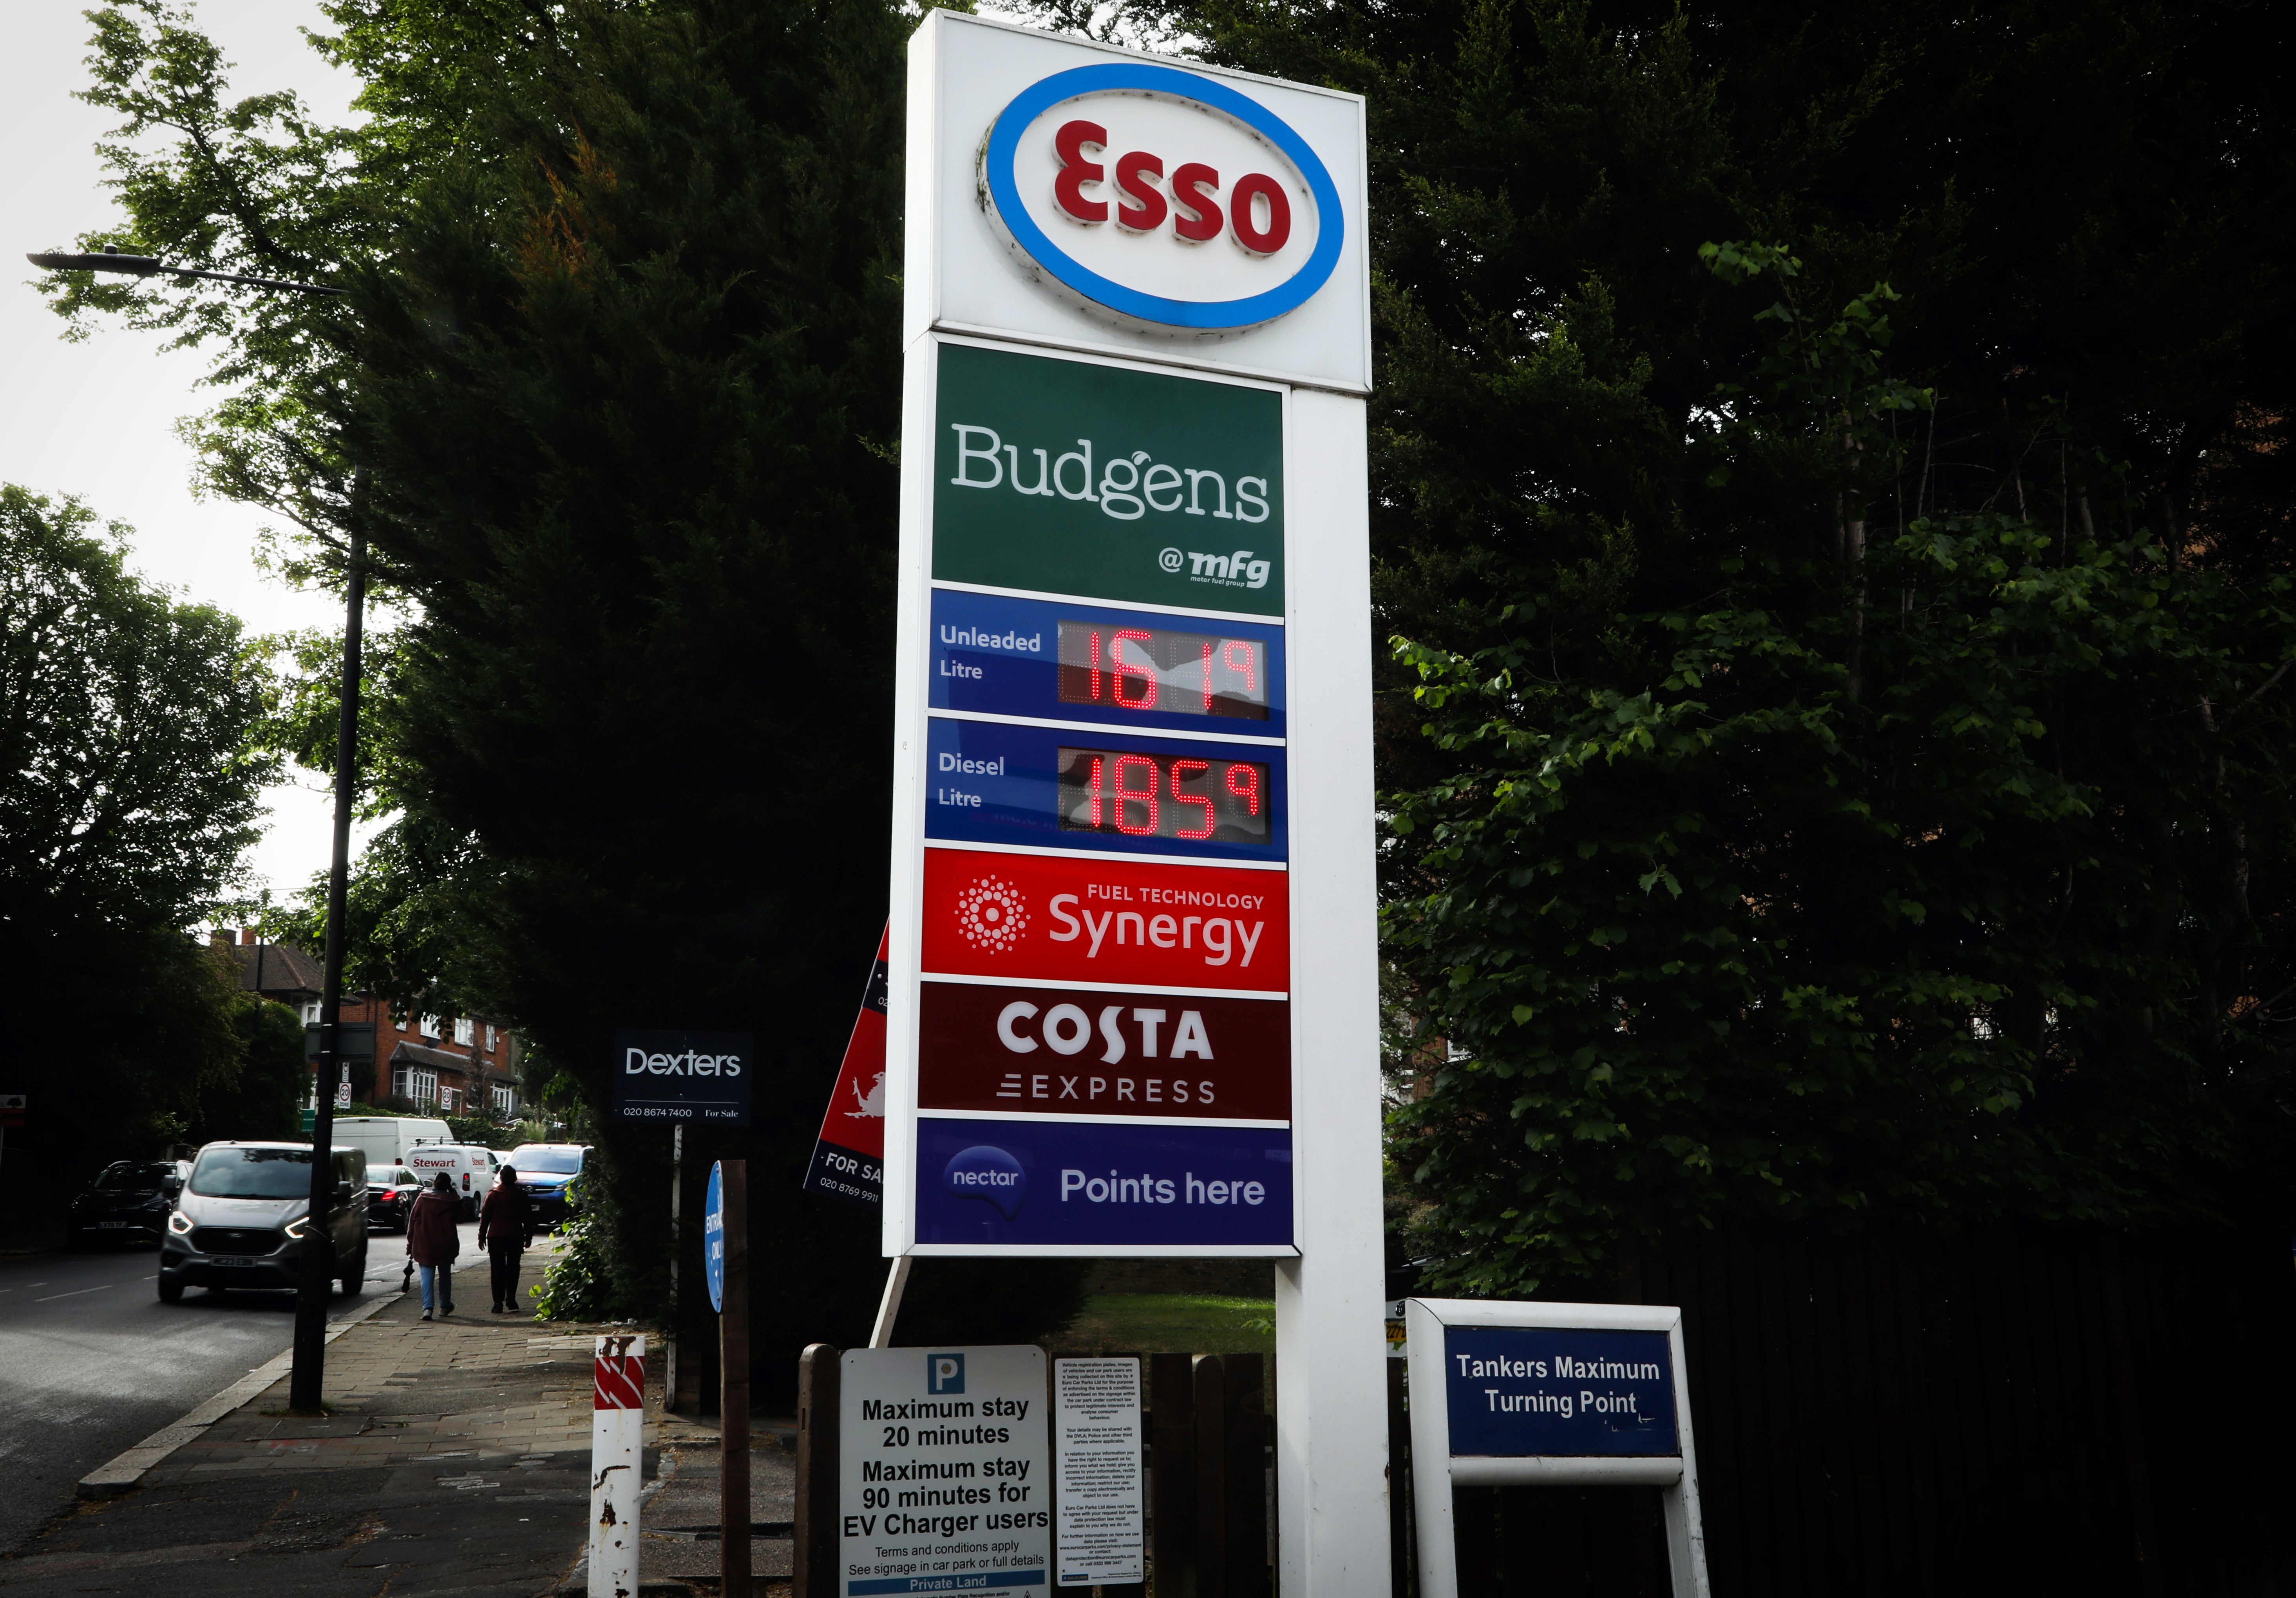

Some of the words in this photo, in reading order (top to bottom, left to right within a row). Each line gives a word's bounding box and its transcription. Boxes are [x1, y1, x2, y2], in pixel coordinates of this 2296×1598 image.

[1055, 120, 1290, 253] Esso
[951, 423, 1270, 523] Budgens
[1159, 547, 1183, 572] @
[1188, 550, 1270, 588] mfg
[941, 625, 1040, 652] Unleaded
[941, 660, 982, 679] Litre
[939, 753, 1003, 775] Diesel
[939, 789, 981, 807] Litre
[1087, 884, 1133, 901] FUEL
[1140, 888, 1264, 910] TECHNOLOGY
[1049, 893, 1265, 967] Synergy
[997, 1001, 1214, 1064] COSTA
[626, 1048, 740, 1076] Dexters
[1032, 1074, 1215, 1104] EXPRESS
[413, 1159, 456, 1167] Stewart
[826, 1153, 858, 1175] FOR
[862, 1165, 883, 1184] SA
[821, 1178, 837, 1189] 020
[839, 1184, 859, 1196] 8769
[862, 1191, 878, 1202] 9911
[954, 1170, 1018, 1185] nectar
[1062, 1169, 1175, 1203] Points
[1186, 1173, 1265, 1205] here
[936, 1359, 958, 1390] P
[1456, 1354, 1547, 1378] Tankers
[1555, 1356, 1659, 1379] Maximum
[863, 1399, 973, 1420] Maximum
[982, 1397, 1029, 1421] stay
[1485, 1390, 1573, 1418] Turning
[1581, 1390, 1636, 1413] Point
[883, 1426, 909, 1447] 20
[918, 1424, 1009, 1446] minutes
[863, 1460, 974, 1482] Maximum
[983, 1457, 1030, 1480] stay
[863, 1488, 889, 1509] 90
[899, 1485, 991, 1507] minutes
[999, 1482, 1030, 1502] for
[844, 1515, 876, 1537] EV
[885, 1513, 979, 1537] Charger
[987, 1512, 1048, 1529] users
[875, 1547, 908, 1557] Terms
[912, 1544, 931, 1555] and
[935, 1542, 988, 1554] conditions
[991, 1540, 1019, 1553] apply
[849, 1565, 870, 1575] See
[874, 1564, 916, 1576] signage
[921, 1561, 929, 1571] in
[933, 1562, 950, 1570] car
[953, 1558, 975, 1572] park
[993, 1556, 1007, 1567] full
[1011, 1555, 1044, 1566] details
[911, 1578, 952, 1590] Private
[957, 1575, 986, 1587] Land
